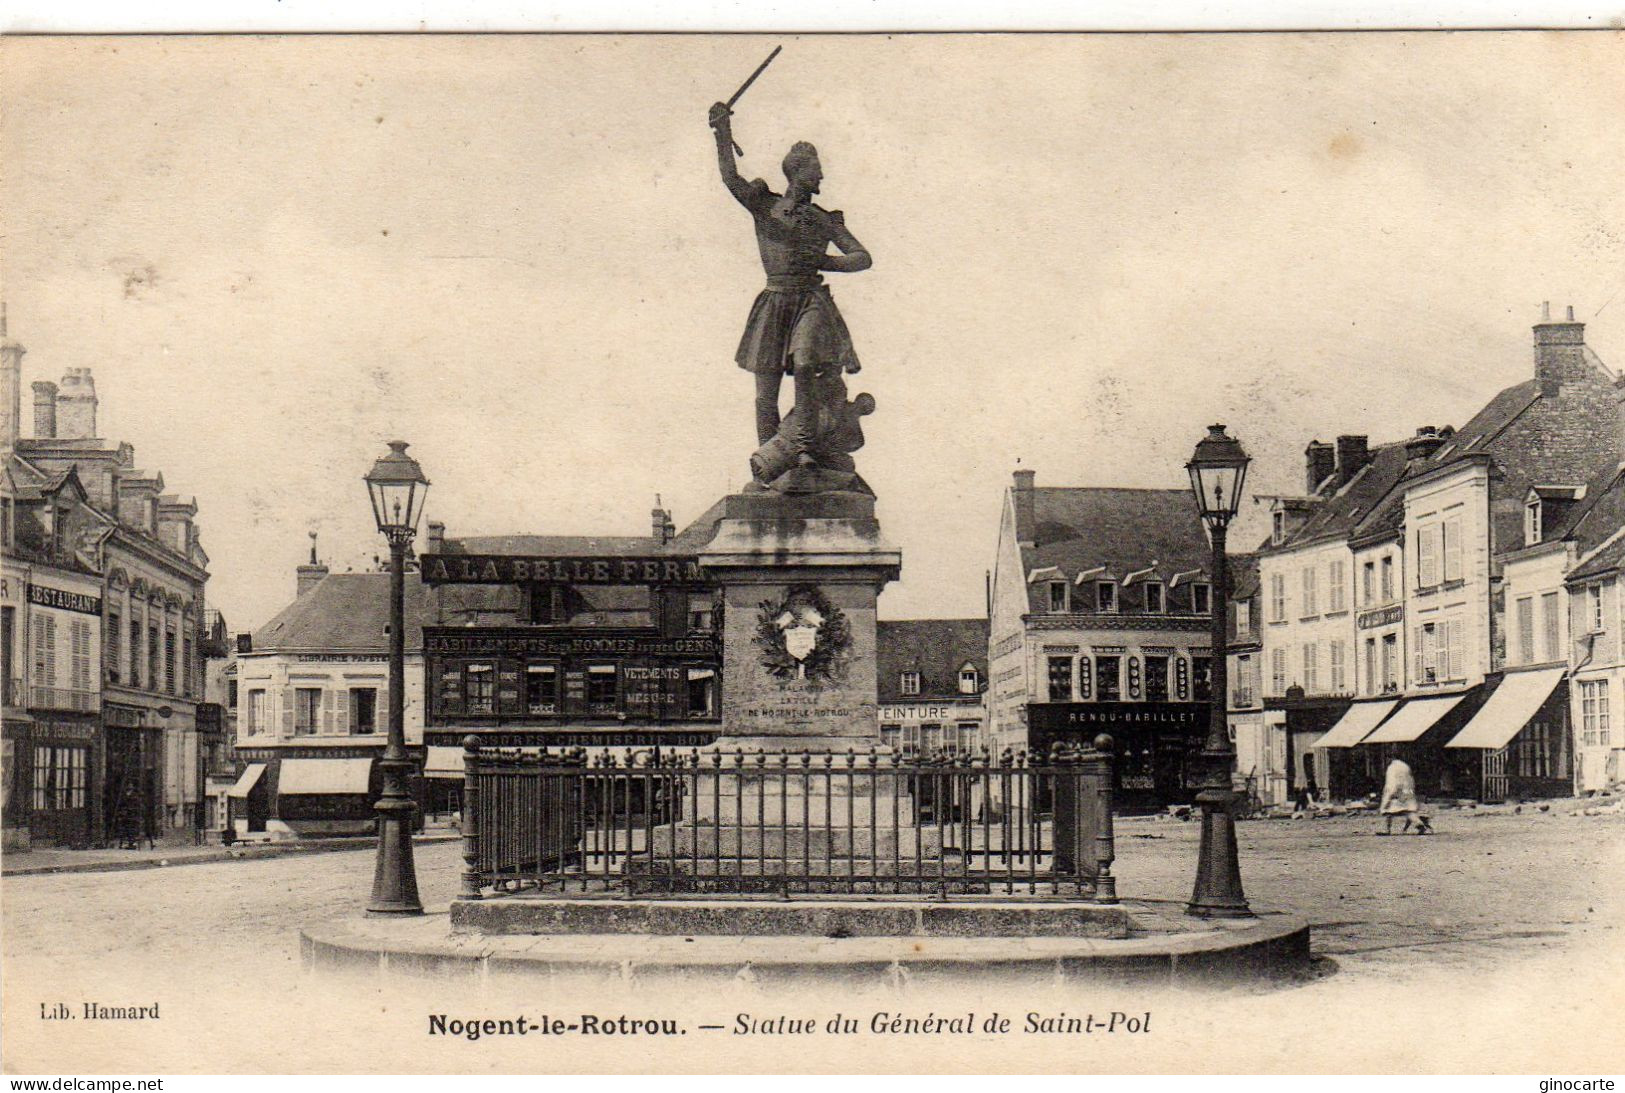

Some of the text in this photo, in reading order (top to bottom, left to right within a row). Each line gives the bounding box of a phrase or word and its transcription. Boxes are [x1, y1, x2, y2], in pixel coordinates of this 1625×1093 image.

[431, 559, 449, 579] A
[461, 559, 499, 579] LA
[513, 560, 610, 581] BELLE
[427, 638, 548, 652] HABILLEMENTS
[572, 638, 635, 651] HOMMES
[674, 639, 714, 652] GENS
[298, 653, 347, 662] LIBRAIRIE
[626, 693, 675, 704] MESURE
[1069, 712, 1196, 722] RENOU-BARILLET
[432, 735, 545, 746] CHASSURES
[556, 733, 667, 746] CHEMISERIE
